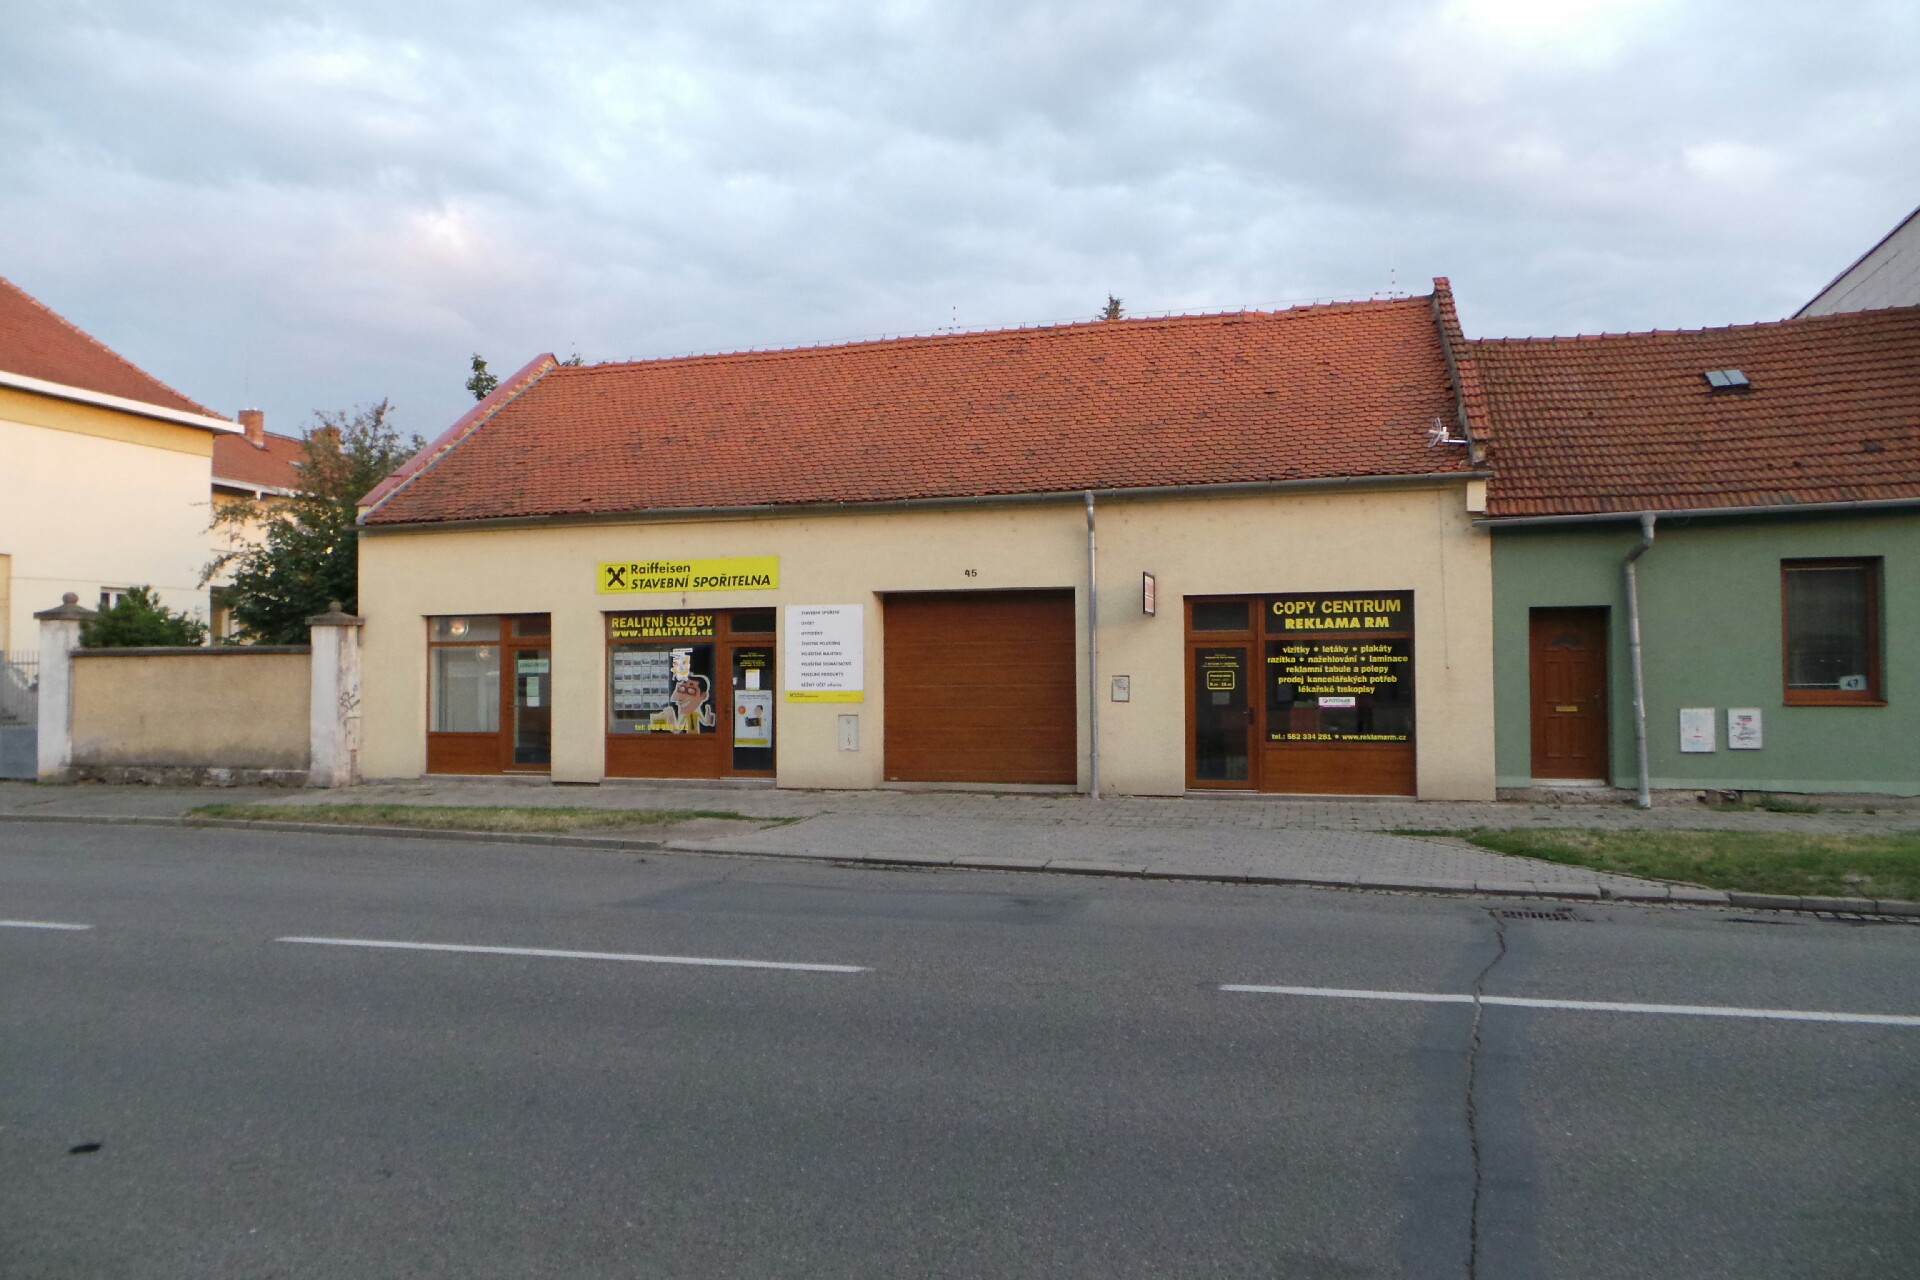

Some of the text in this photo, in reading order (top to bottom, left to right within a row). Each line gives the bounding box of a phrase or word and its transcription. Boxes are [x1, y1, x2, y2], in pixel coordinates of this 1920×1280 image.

[630, 563, 691, 575] Raiffeisen
[964, 569, 978, 578] 45
[631, 573, 771, 590] STAVEBNÍ SPOŘITELNA
[1273, 599, 1401, 615] COPY CENTRUM
[611, 613, 712, 628] REALITNÍ SLUŽBY
[1285, 616, 1390, 629] REKLAMA RM
[612, 627, 712, 637] www.REALITYRS.cz
[1283, 645, 1392, 654] vizitky letáky plakáty
[1308, 655, 1357, 663] nažehlování
[1286, 665, 1322, 673] reklamní
[1325, 665, 1351, 673] tabule
[1361, 665, 1389, 673] polepy
[1278, 675, 1398, 684] prodej kancelářských potřeb
[1298, 685, 1375, 694] lékařské tiskopisy
